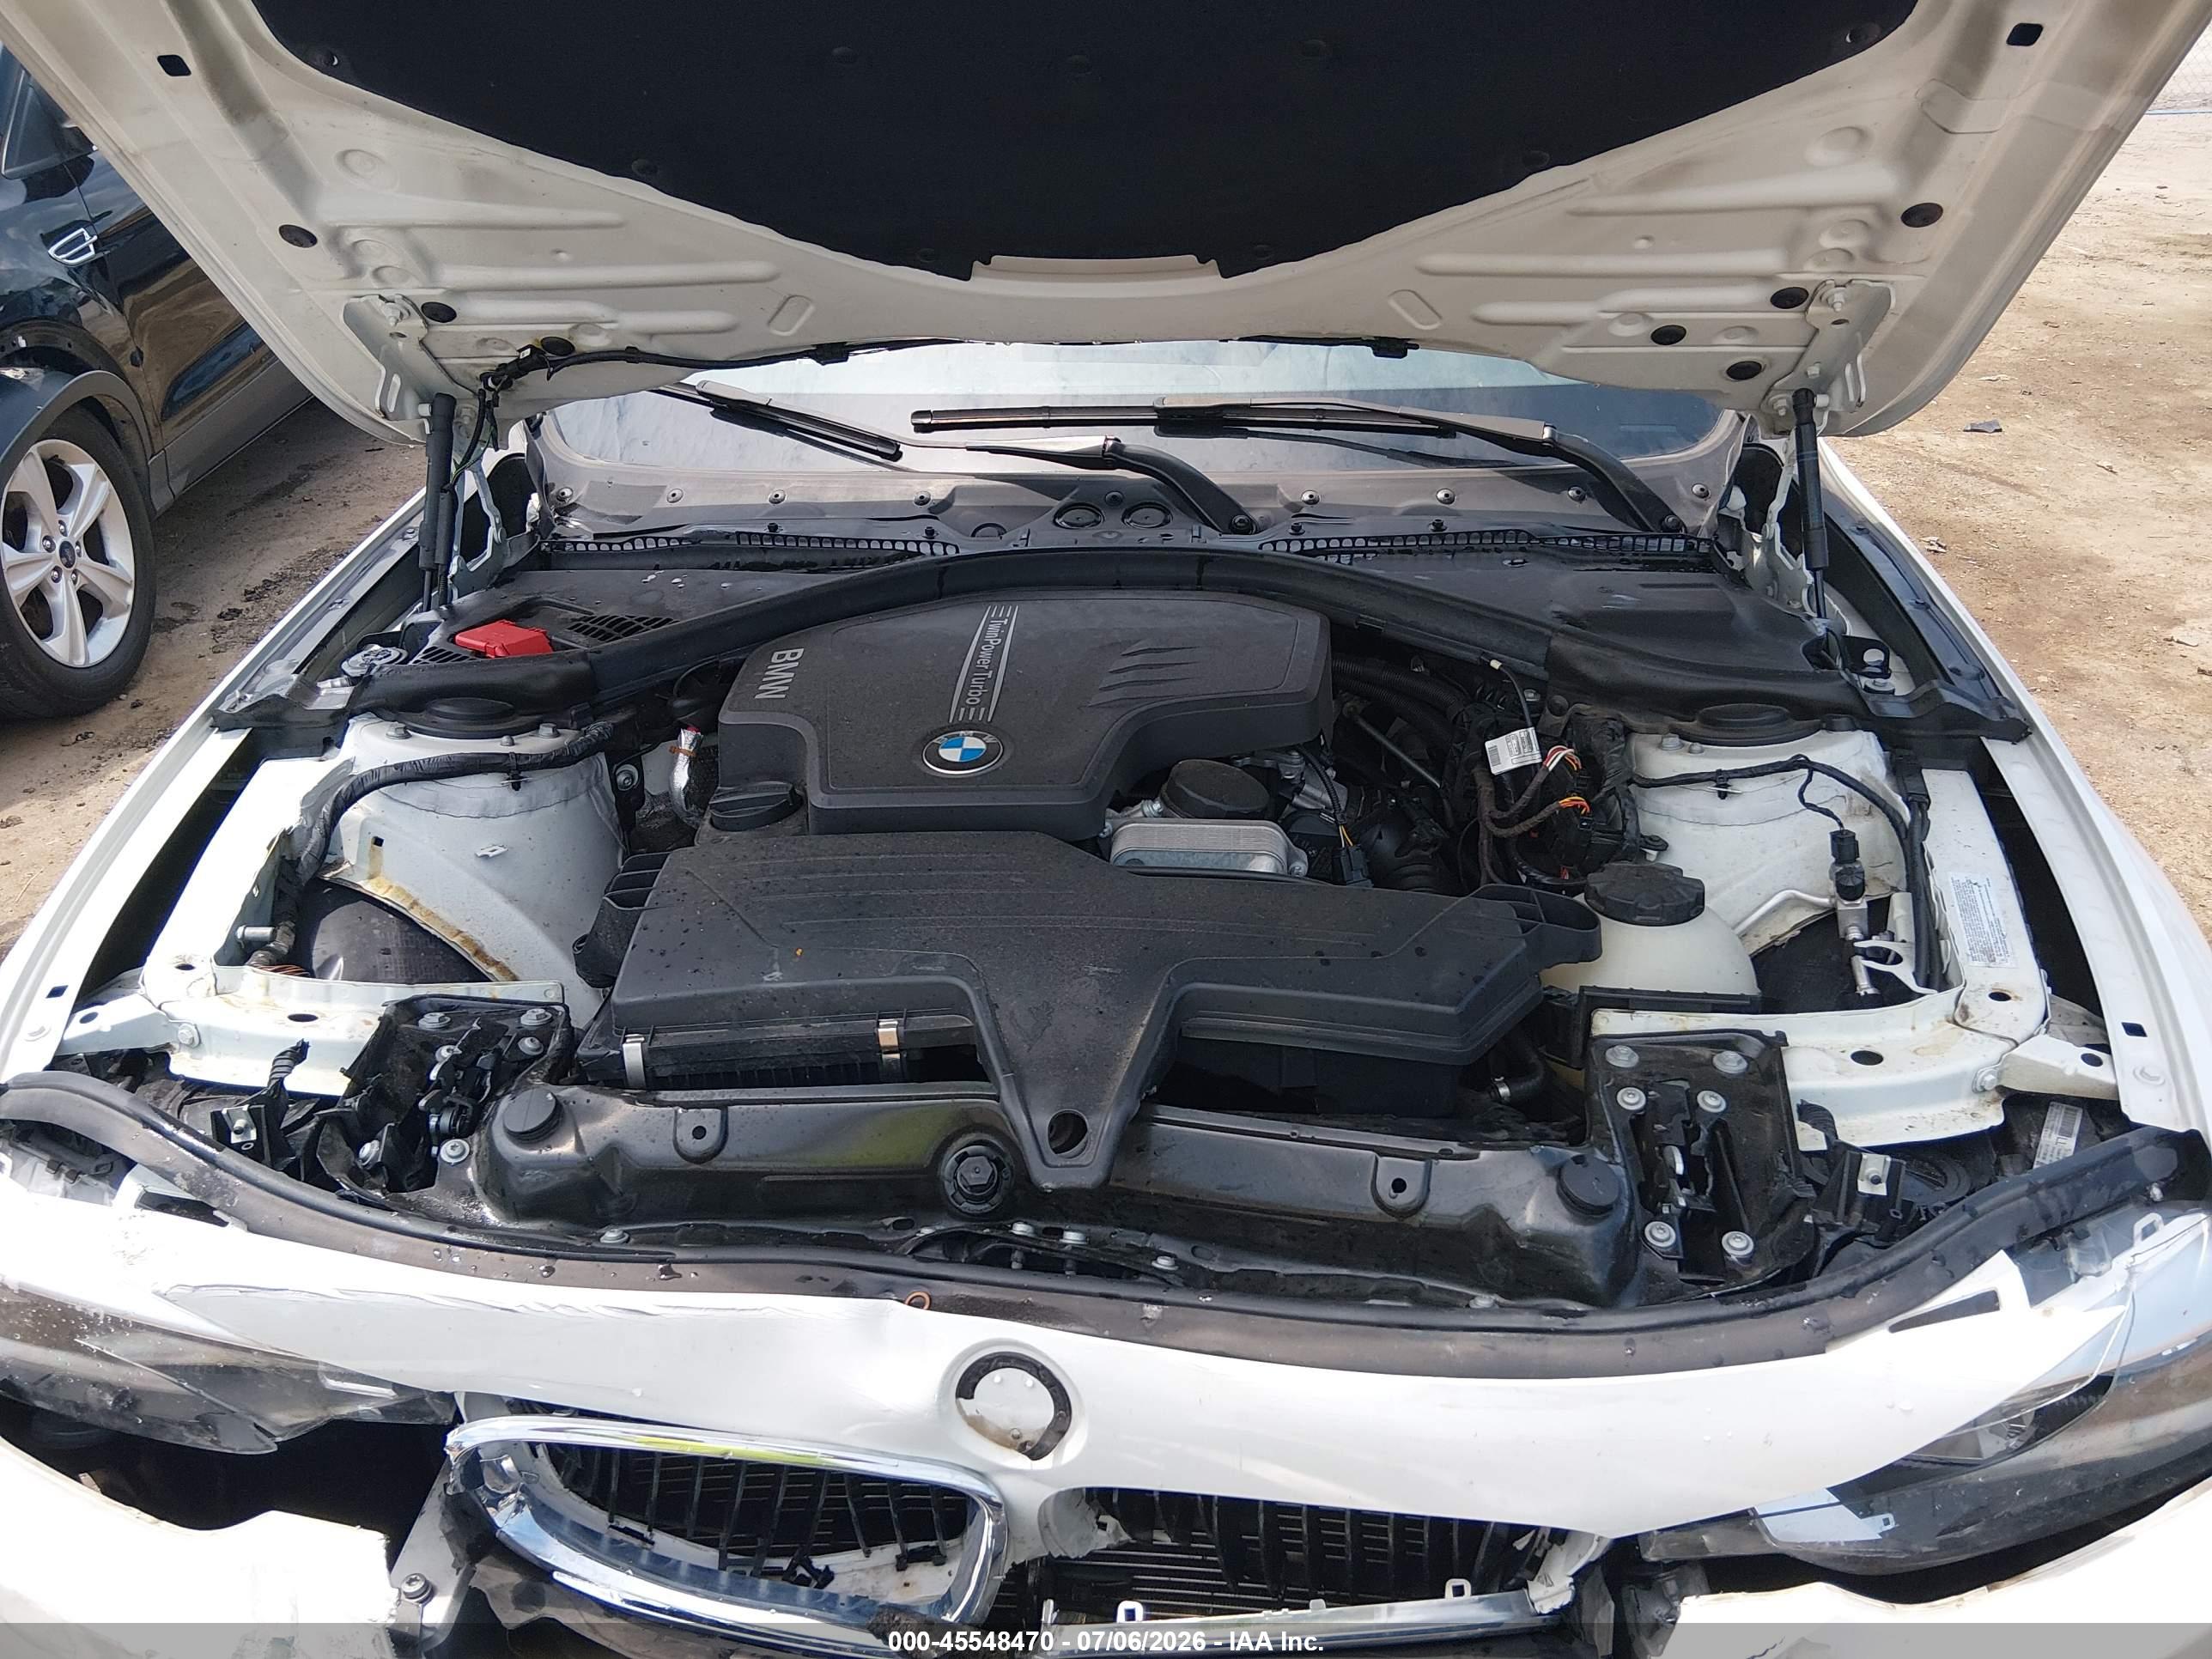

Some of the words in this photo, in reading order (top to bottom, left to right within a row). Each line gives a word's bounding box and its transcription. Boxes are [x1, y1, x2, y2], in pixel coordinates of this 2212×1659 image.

[975, 618, 1009, 670] TwinPower
[754, 647, 805, 699] BMW
[965, 670, 994, 705] Turbo
